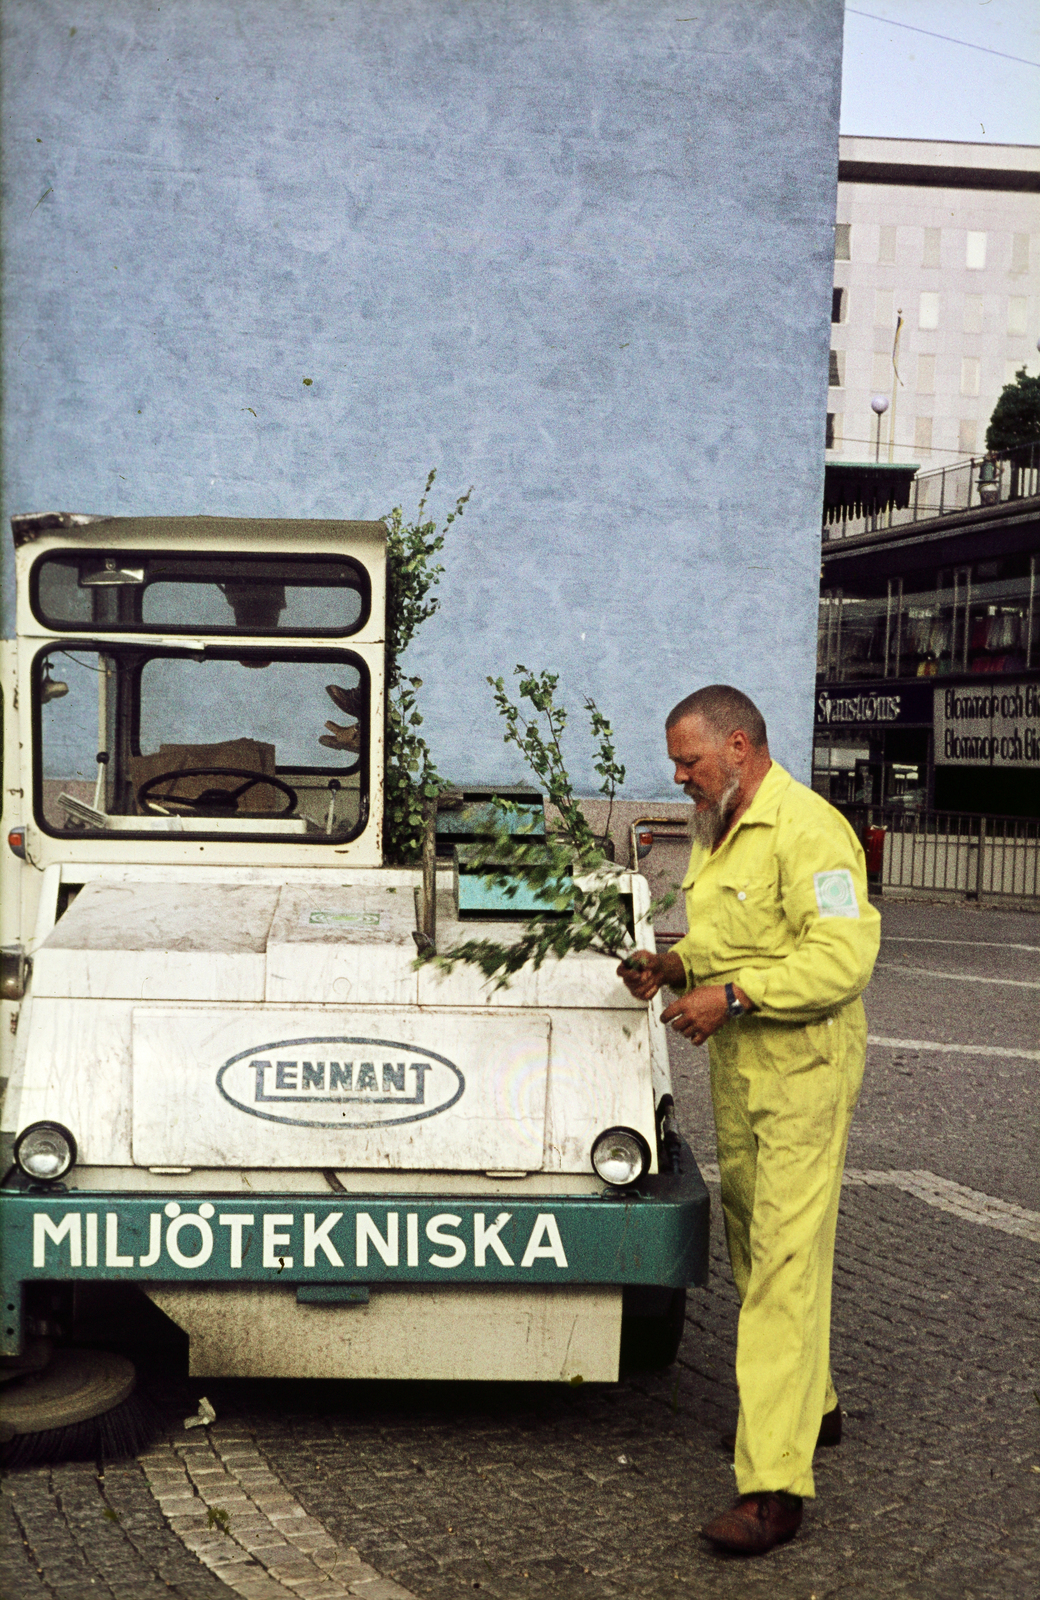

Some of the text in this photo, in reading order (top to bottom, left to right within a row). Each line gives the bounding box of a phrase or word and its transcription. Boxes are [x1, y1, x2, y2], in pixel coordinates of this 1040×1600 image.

[1001, 686, 1023, 718] och
[1001, 728, 1022, 759] och
[248, 1060, 433, 1105] TENNANT
[32, 1201, 569, 1269] MILJÖTEKNISKA
